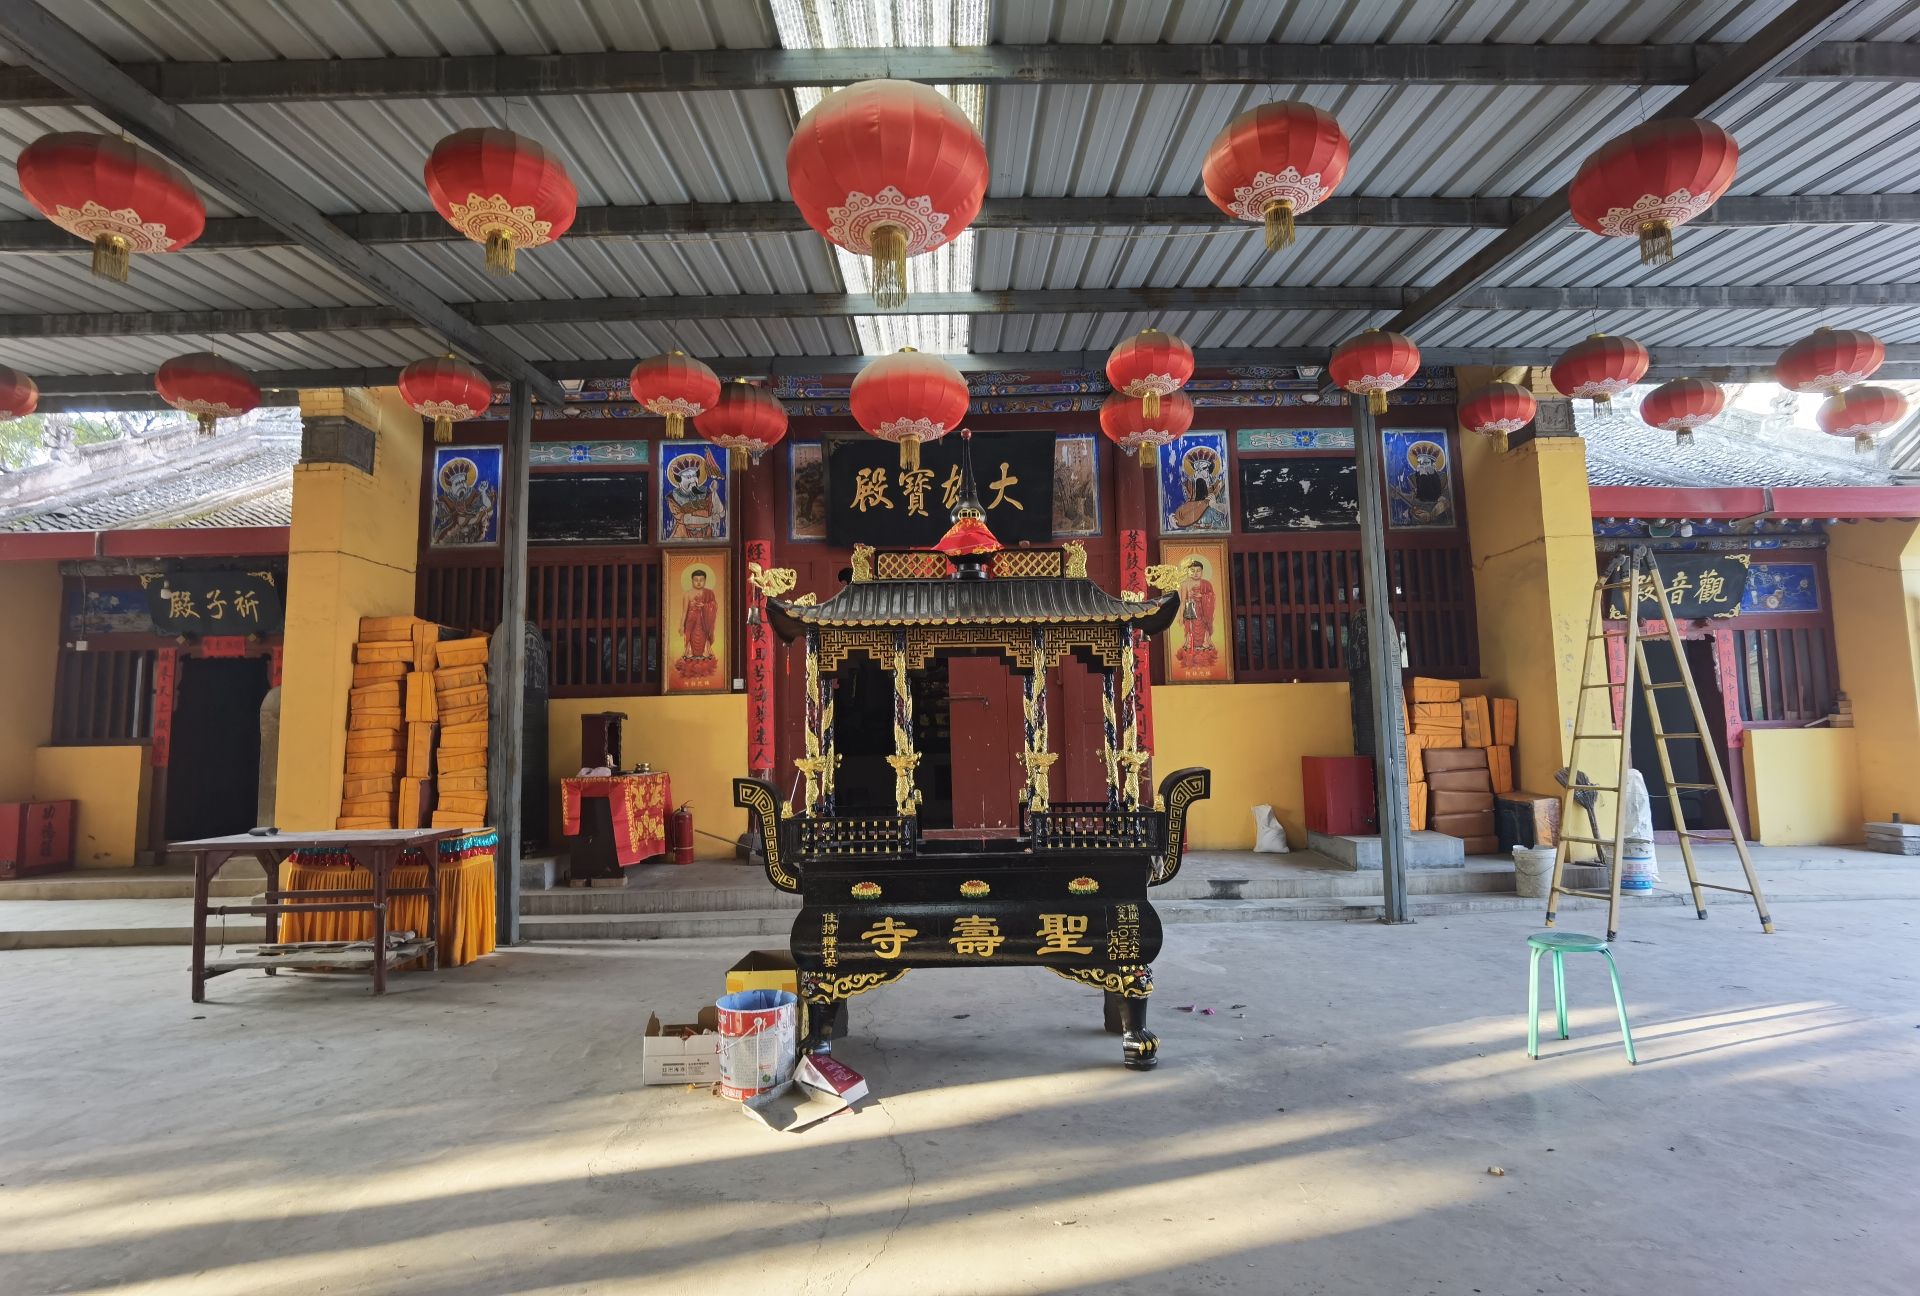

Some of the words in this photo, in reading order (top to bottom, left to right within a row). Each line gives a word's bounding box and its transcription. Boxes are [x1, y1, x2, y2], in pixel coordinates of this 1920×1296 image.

[169, 589, 259, 623] 祈子殿
[861, 913, 1094, 959] 聖壽寺
[1107, 929, 1119, 960] 七月八日
